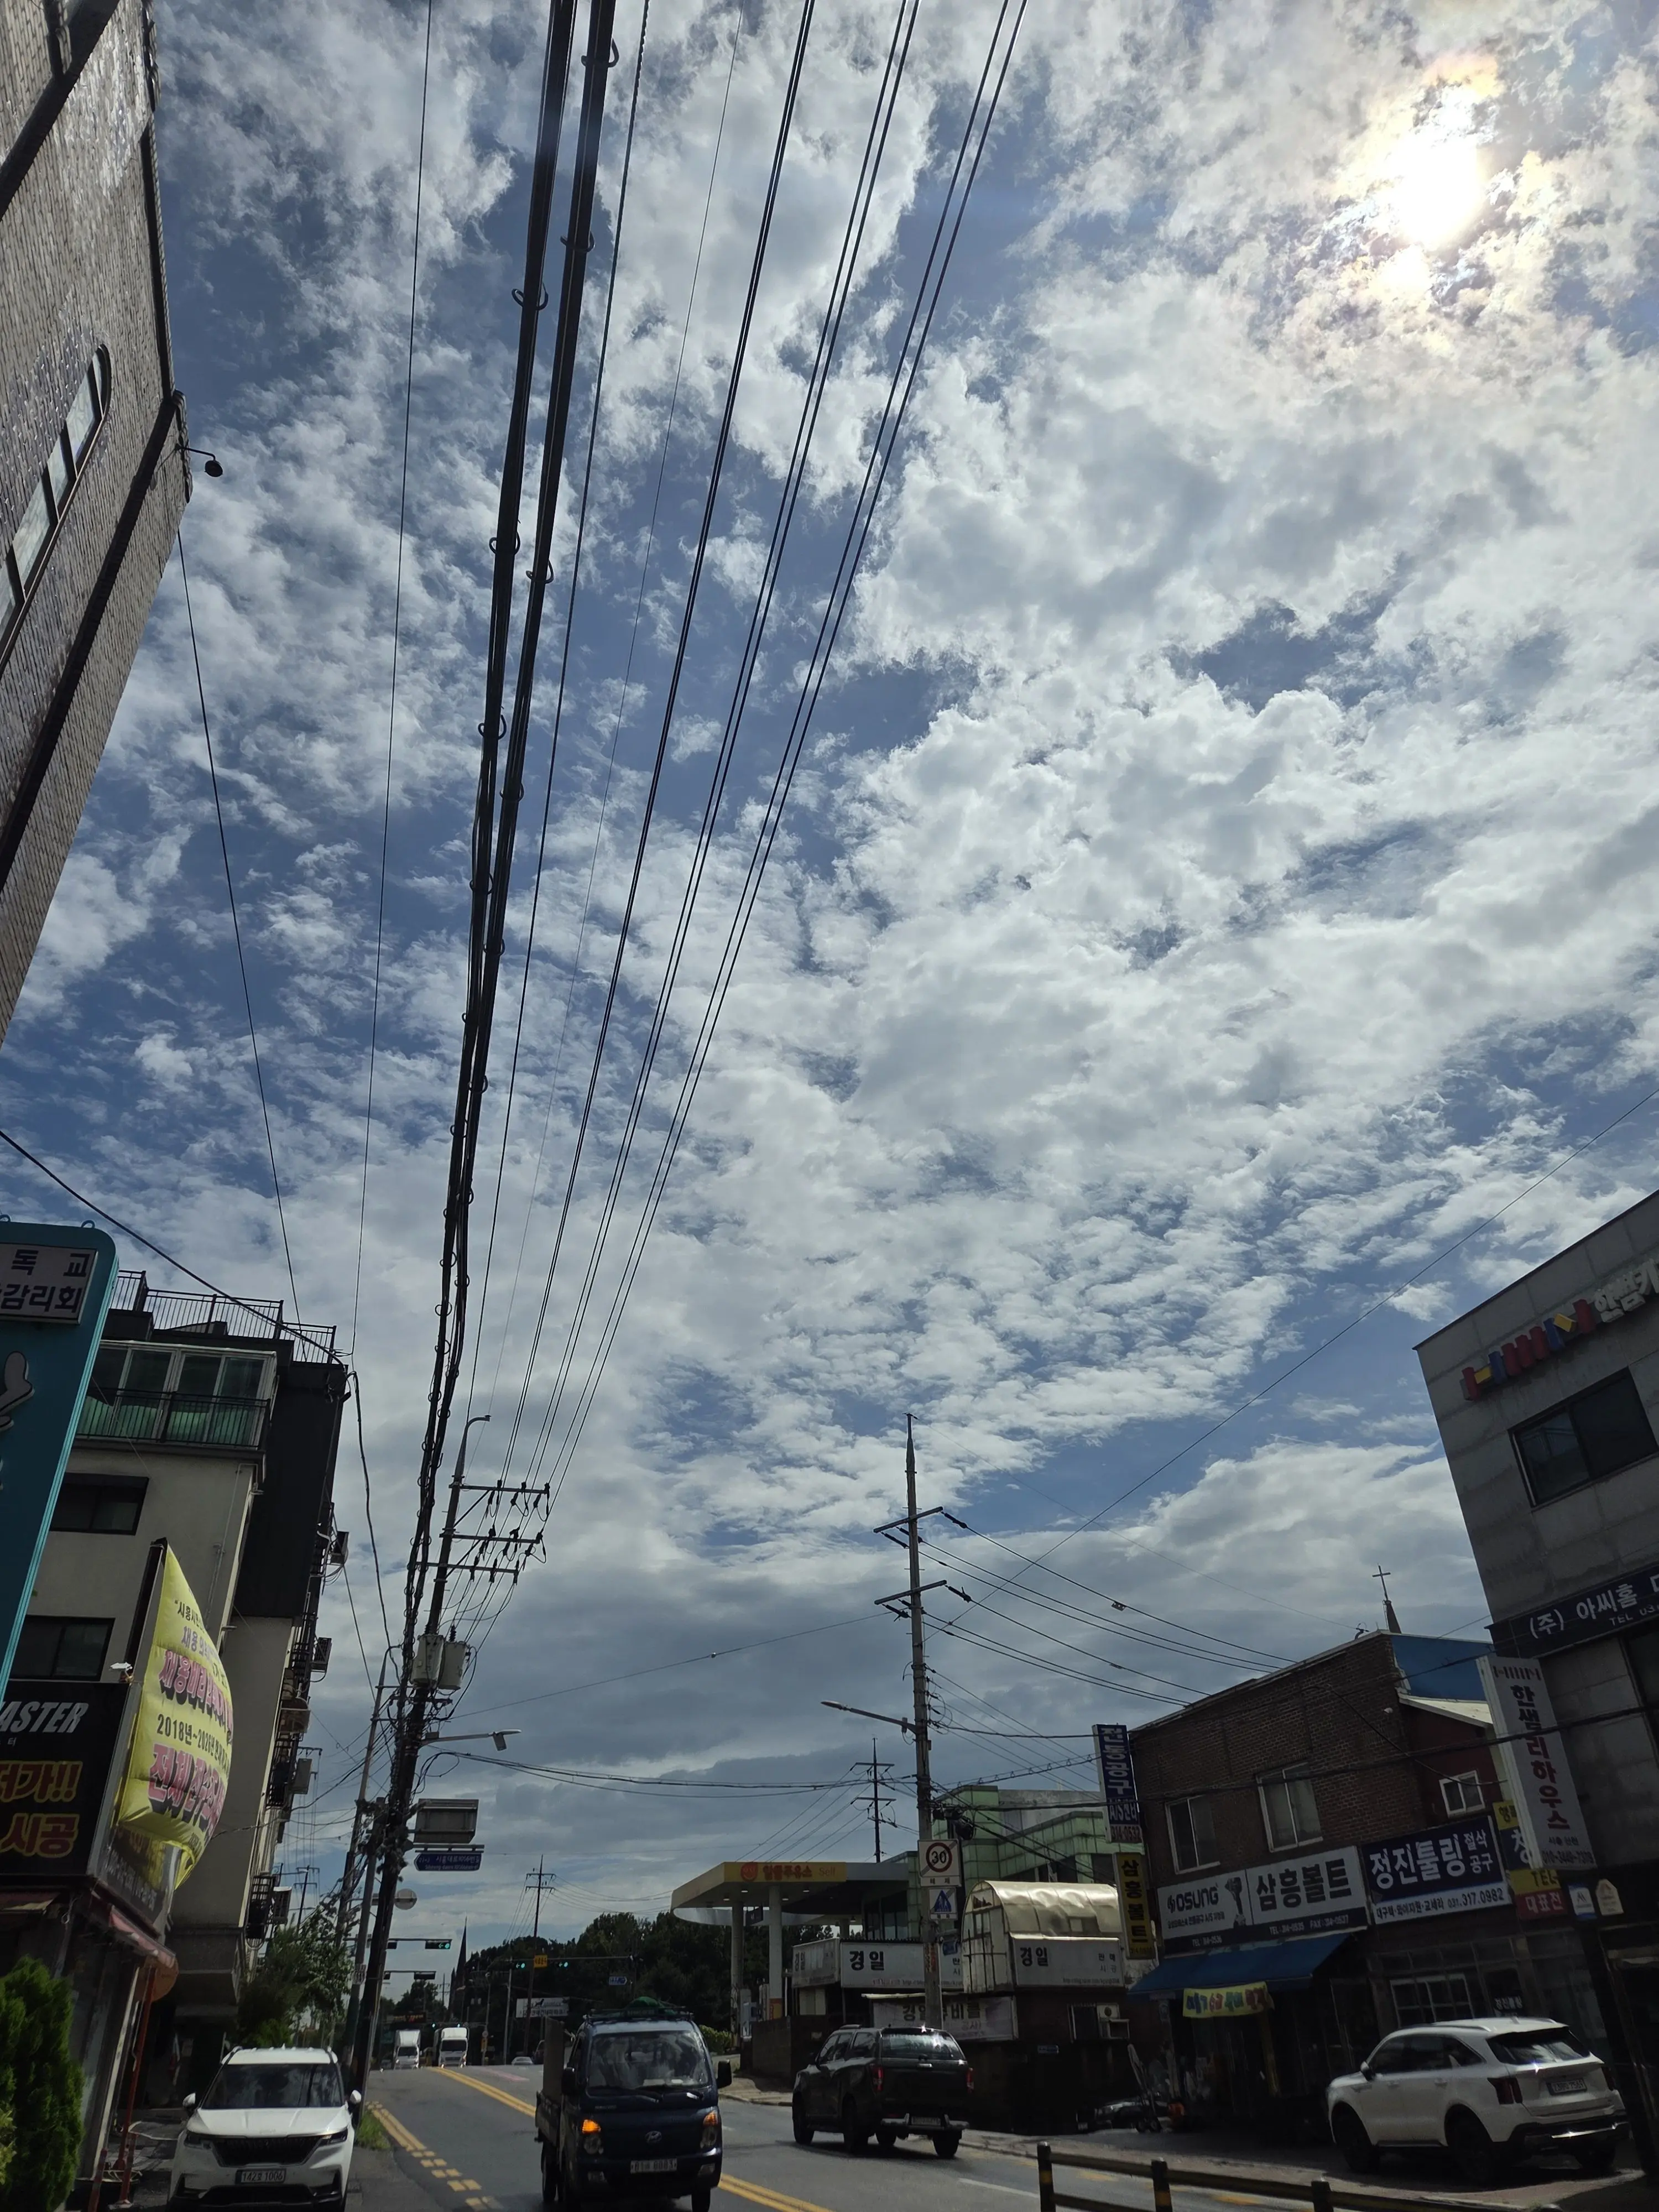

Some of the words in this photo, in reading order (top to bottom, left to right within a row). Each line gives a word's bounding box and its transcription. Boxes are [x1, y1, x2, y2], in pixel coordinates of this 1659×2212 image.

[0, 1284, 82, 1313] 감리회
[1530, 1609, 1564, 1639] (주)
[1577, 1583, 1637, 1619] 아씨홈
[1609, 1613, 1634, 1626] TEL
[0, 1701, 89, 1733] ASTER
[1101, 1727, 1133, 1795] 전동공구
[1510, 1684, 1571, 1830] 한샘리하우스
[819, 1867, 836, 1877] Self
[932, 1851, 946, 1864] 30
[1369, 1833, 1466, 1889] 정진툴링
[1463, 1829, 1488, 1851] 절삭
[1469, 1853, 1494, 1874] 공구
[1256, 1858, 1352, 1911] 삼흥볼트
[1121, 1860, 1148, 1943] 삼흥볼트
[849, 1950, 884, 1971] 경일
[1020, 1947, 1048, 1966] 경일
